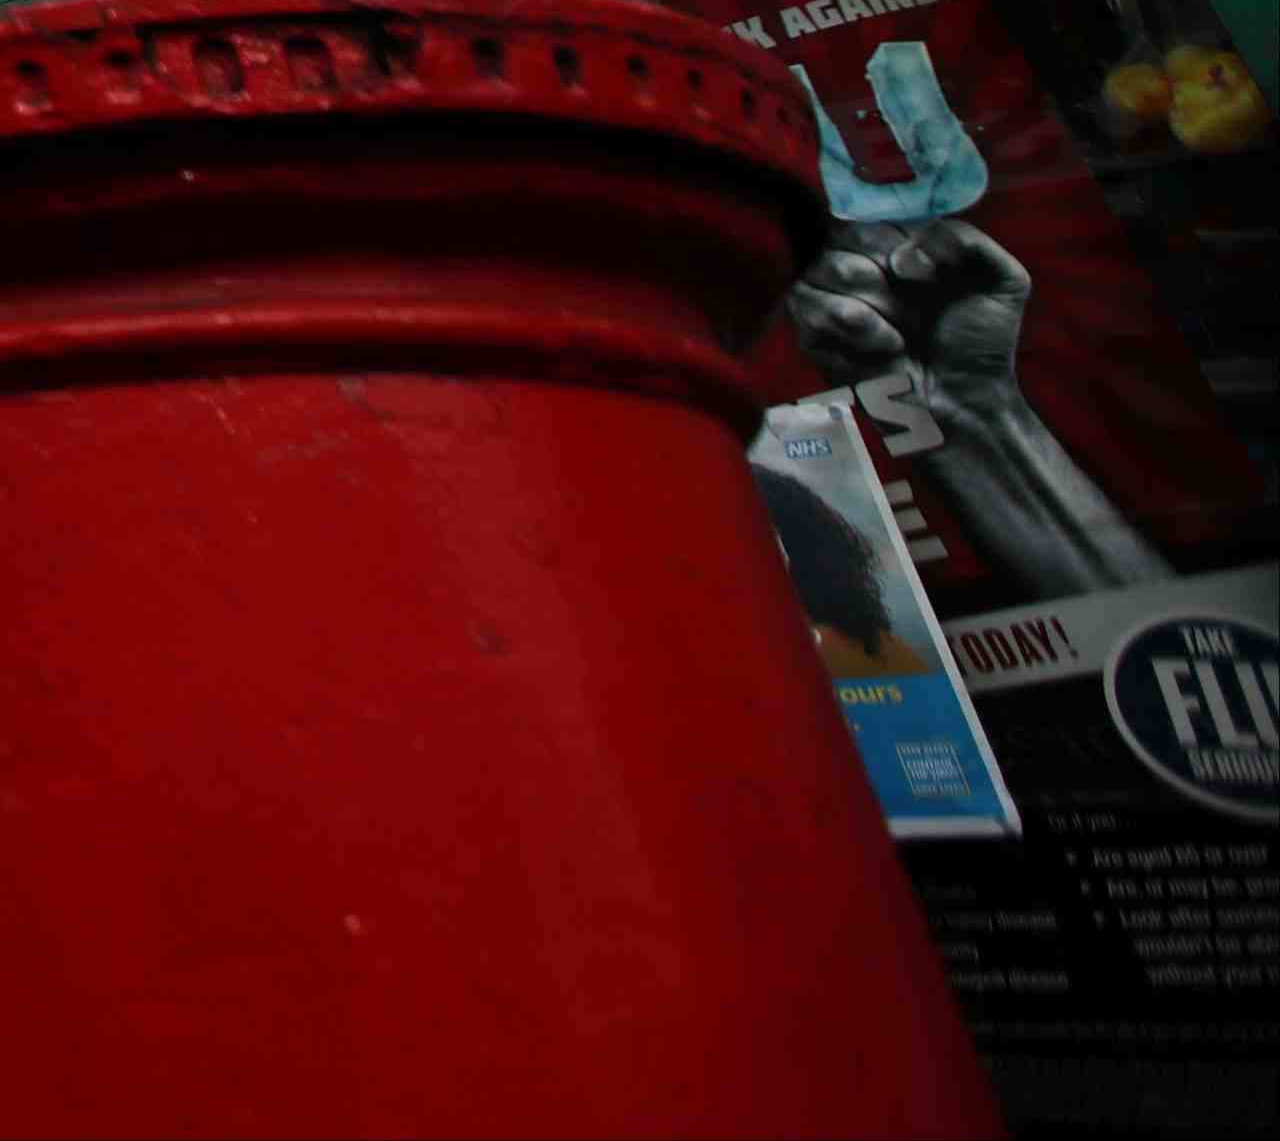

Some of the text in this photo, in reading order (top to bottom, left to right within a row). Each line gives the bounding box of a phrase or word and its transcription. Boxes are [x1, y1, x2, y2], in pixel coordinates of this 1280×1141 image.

[784, 437, 833, 459] NHS
[1179, 625, 1237, 657] TAKE
[1127, 844, 1173, 873] aged
